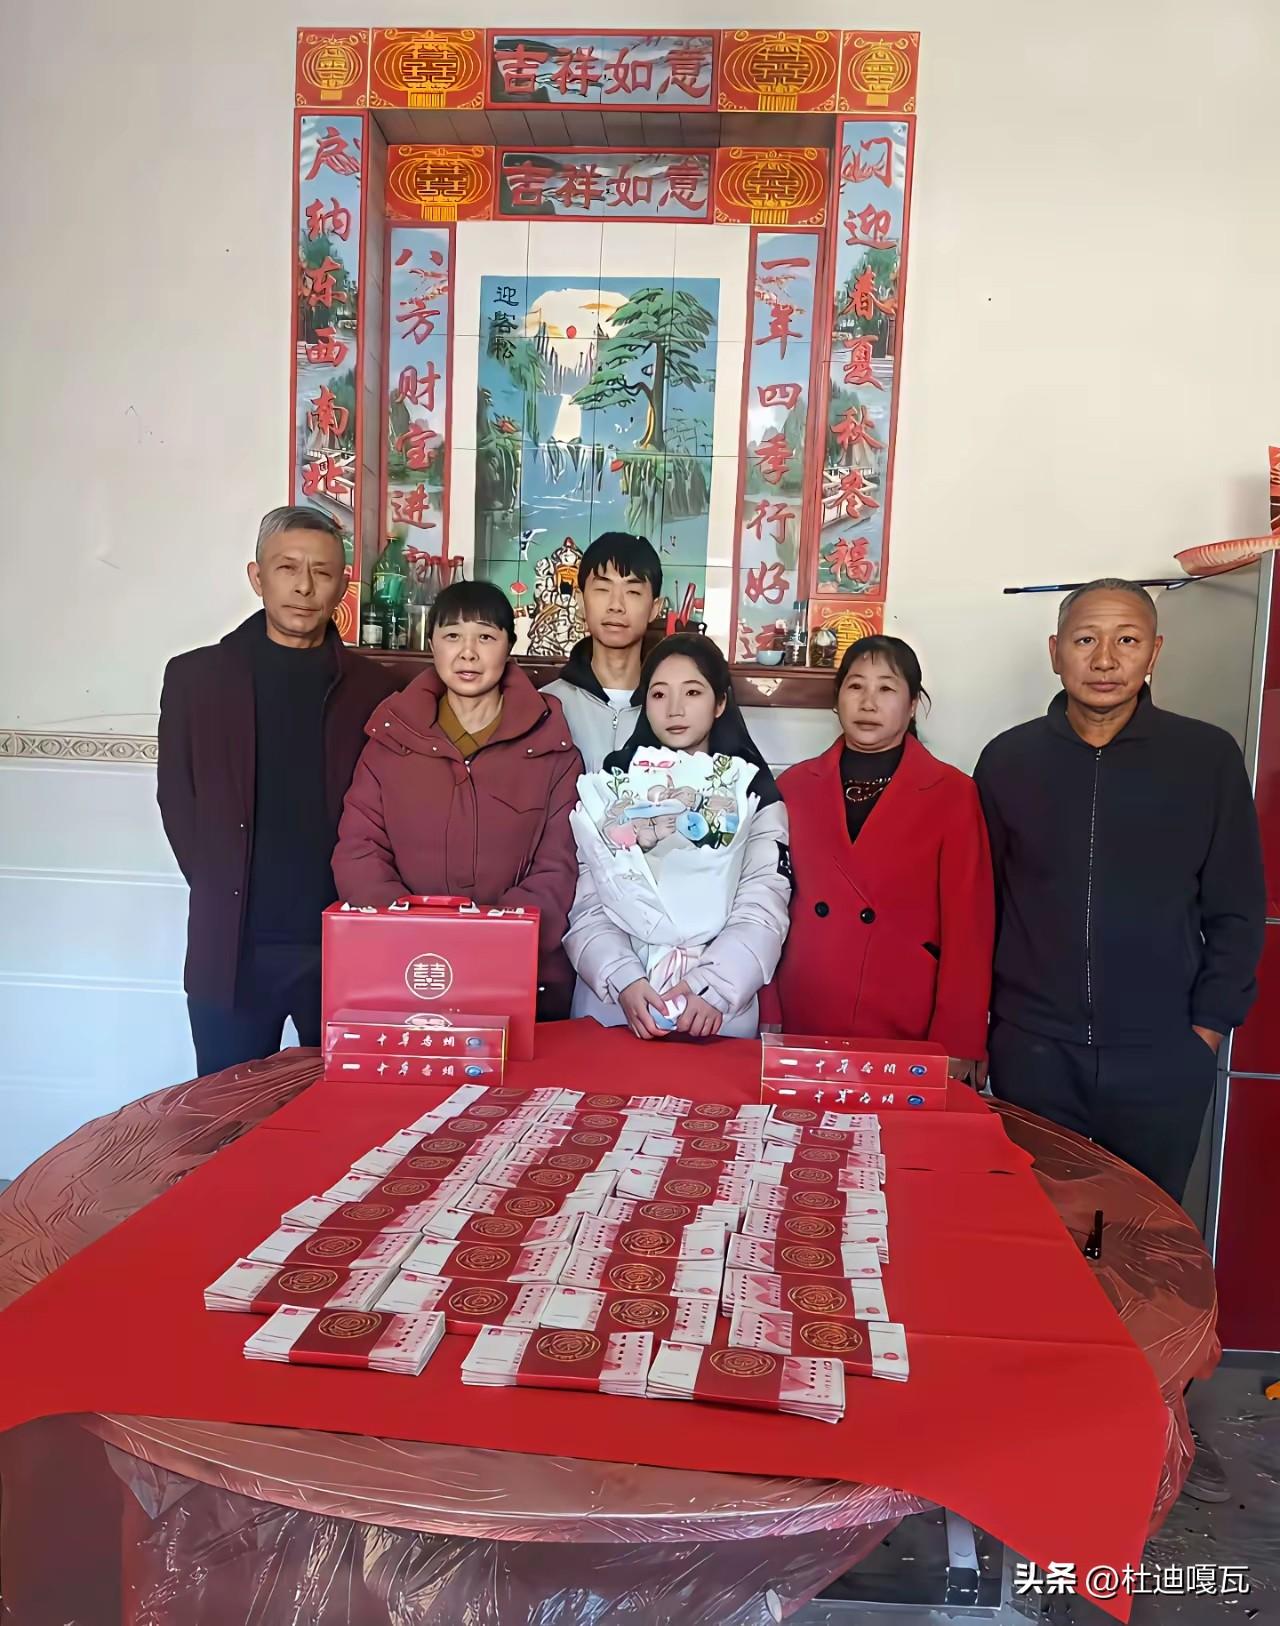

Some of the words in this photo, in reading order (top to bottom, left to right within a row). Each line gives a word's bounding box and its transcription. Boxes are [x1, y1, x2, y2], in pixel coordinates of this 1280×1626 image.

[494, 45, 714, 98] 吉祥如意
[504, 156, 708, 211] 吉祥如意
[487, 286, 519, 361] 迎客松
